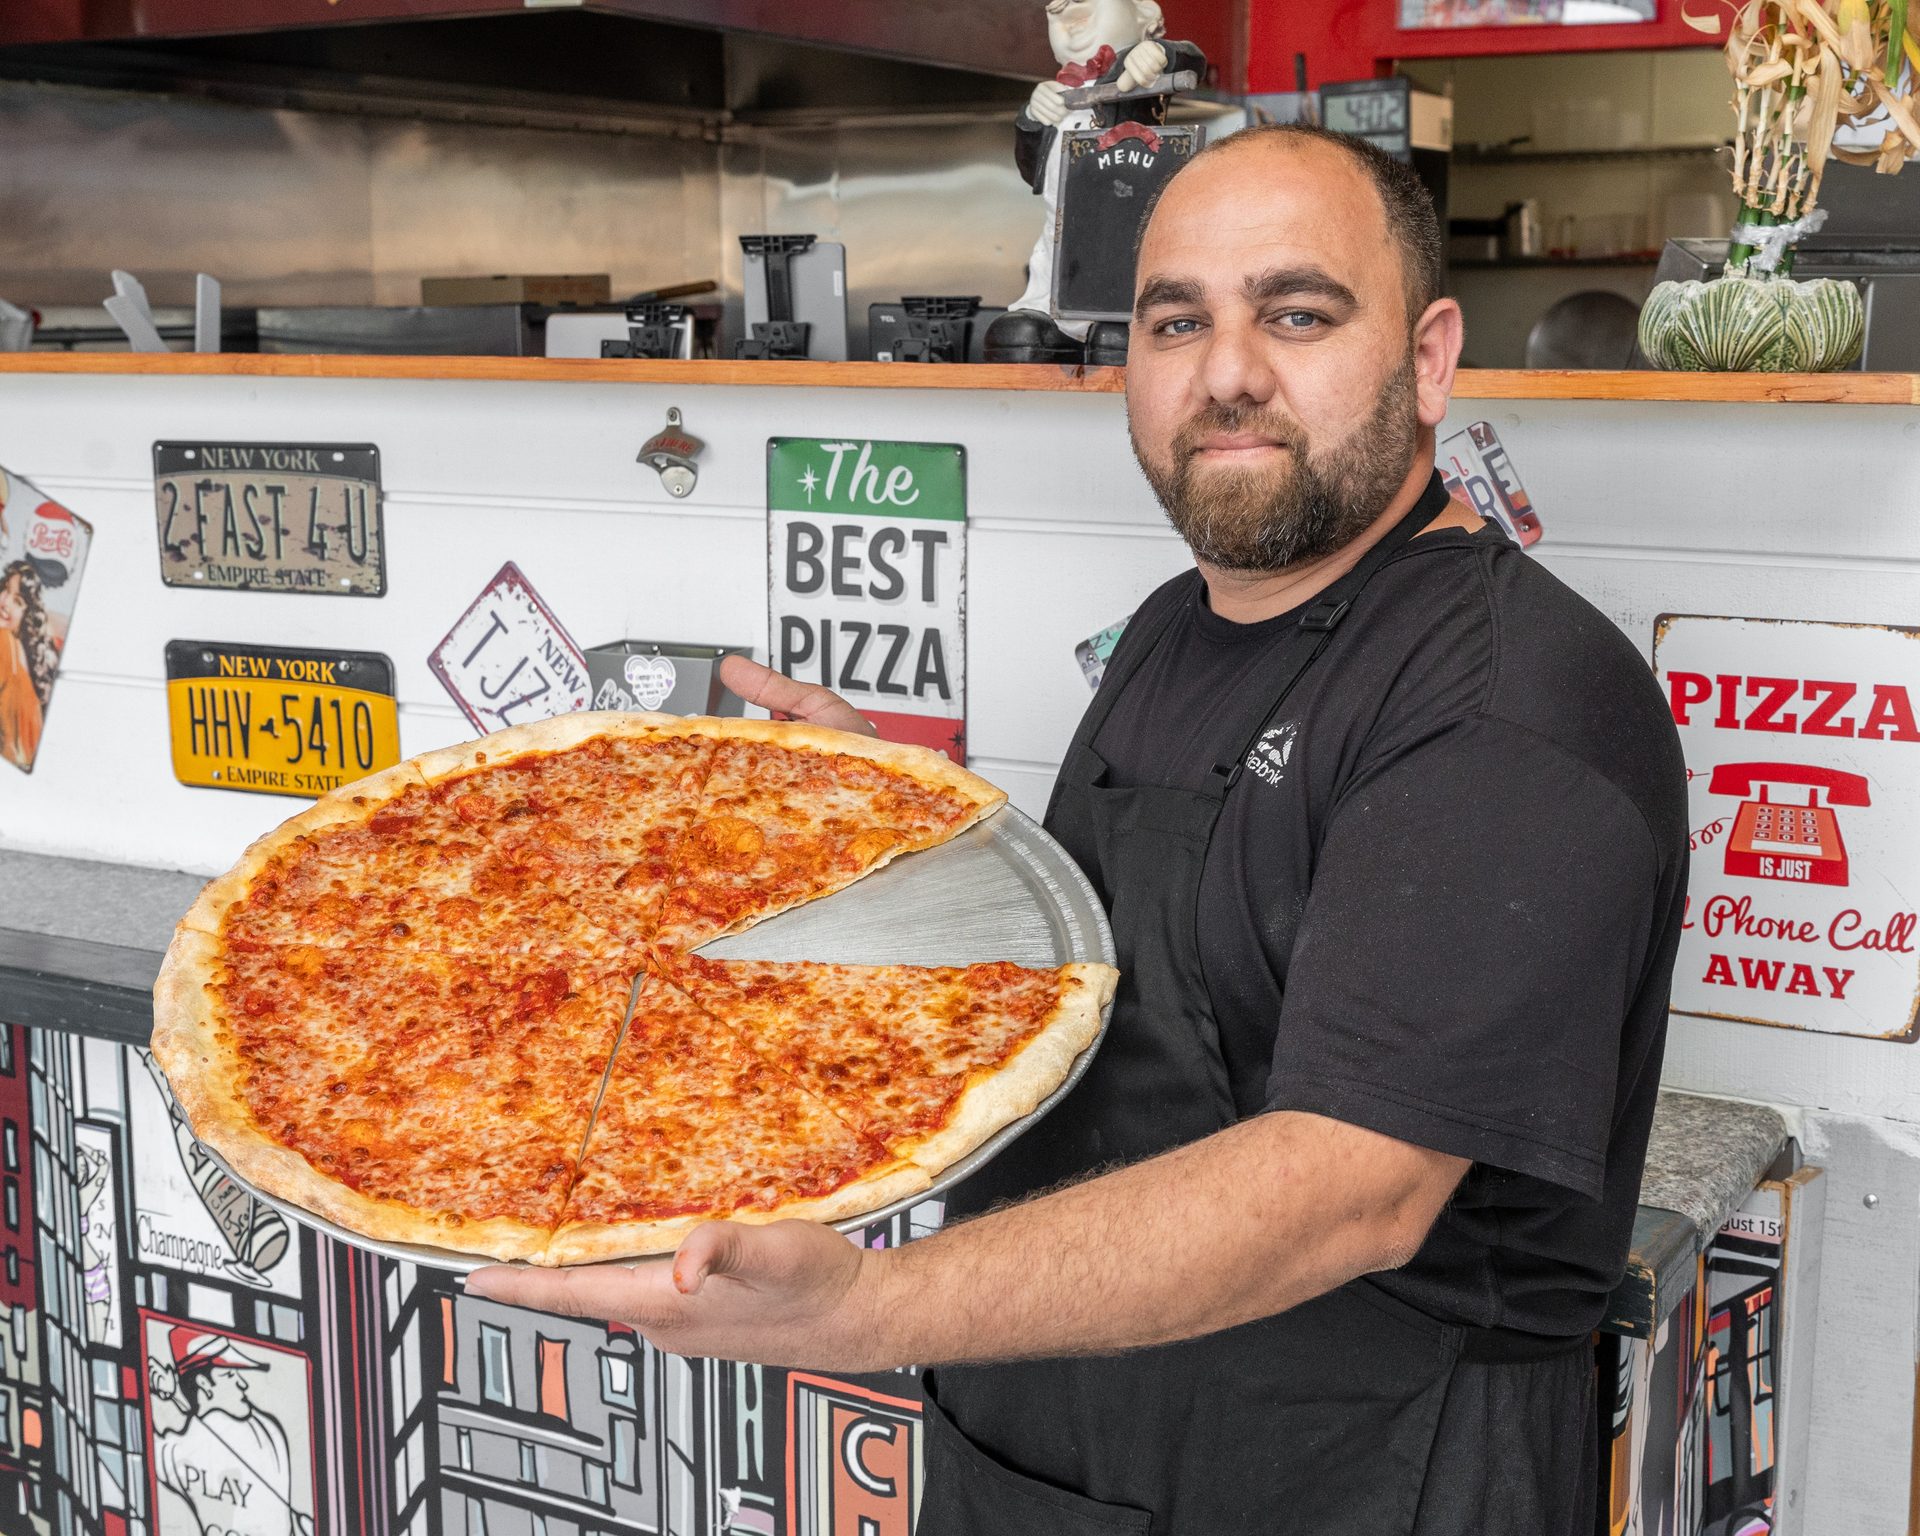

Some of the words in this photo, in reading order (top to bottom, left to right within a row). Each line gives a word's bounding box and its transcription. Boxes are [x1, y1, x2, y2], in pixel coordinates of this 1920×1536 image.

[1097, 148, 1155, 170] MENU
[201, 447, 253, 469] NEW
[260, 449, 321, 472] YORK
[820, 441, 920, 506] The
[308, 484, 329, 561] 4
[343, 484, 367, 564] U
[207, 564, 270, 584] EMPIRE
[275, 567, 326, 587] STATE
[786, 520, 949, 604] BEST
[218, 655, 272, 678] NEW
[275, 658, 337, 684] YORK
[537, 635, 587, 695] NEW
[780, 615, 952, 700] PIZZA
[188, 687, 251, 760] HHV
[281, 694, 374, 771] 5410
[1667, 671, 1920, 743] PIZZA
[227, 766, 290, 788] EMPIRE
[294, 774, 344, 791] STATE
[1759, 856, 1775, 877] IS
[1776, 858, 1813, 881] JUST
[1703, 895, 1821, 944] Phone
[1828, 909, 1918, 953] Call
[1702, 953, 1855, 1000] AWAY
[137, 1214, 223, 1275] Champagne
[1720, 1217, 1755, 1232] gust
[184, 1463, 253, 1508] PLAY
